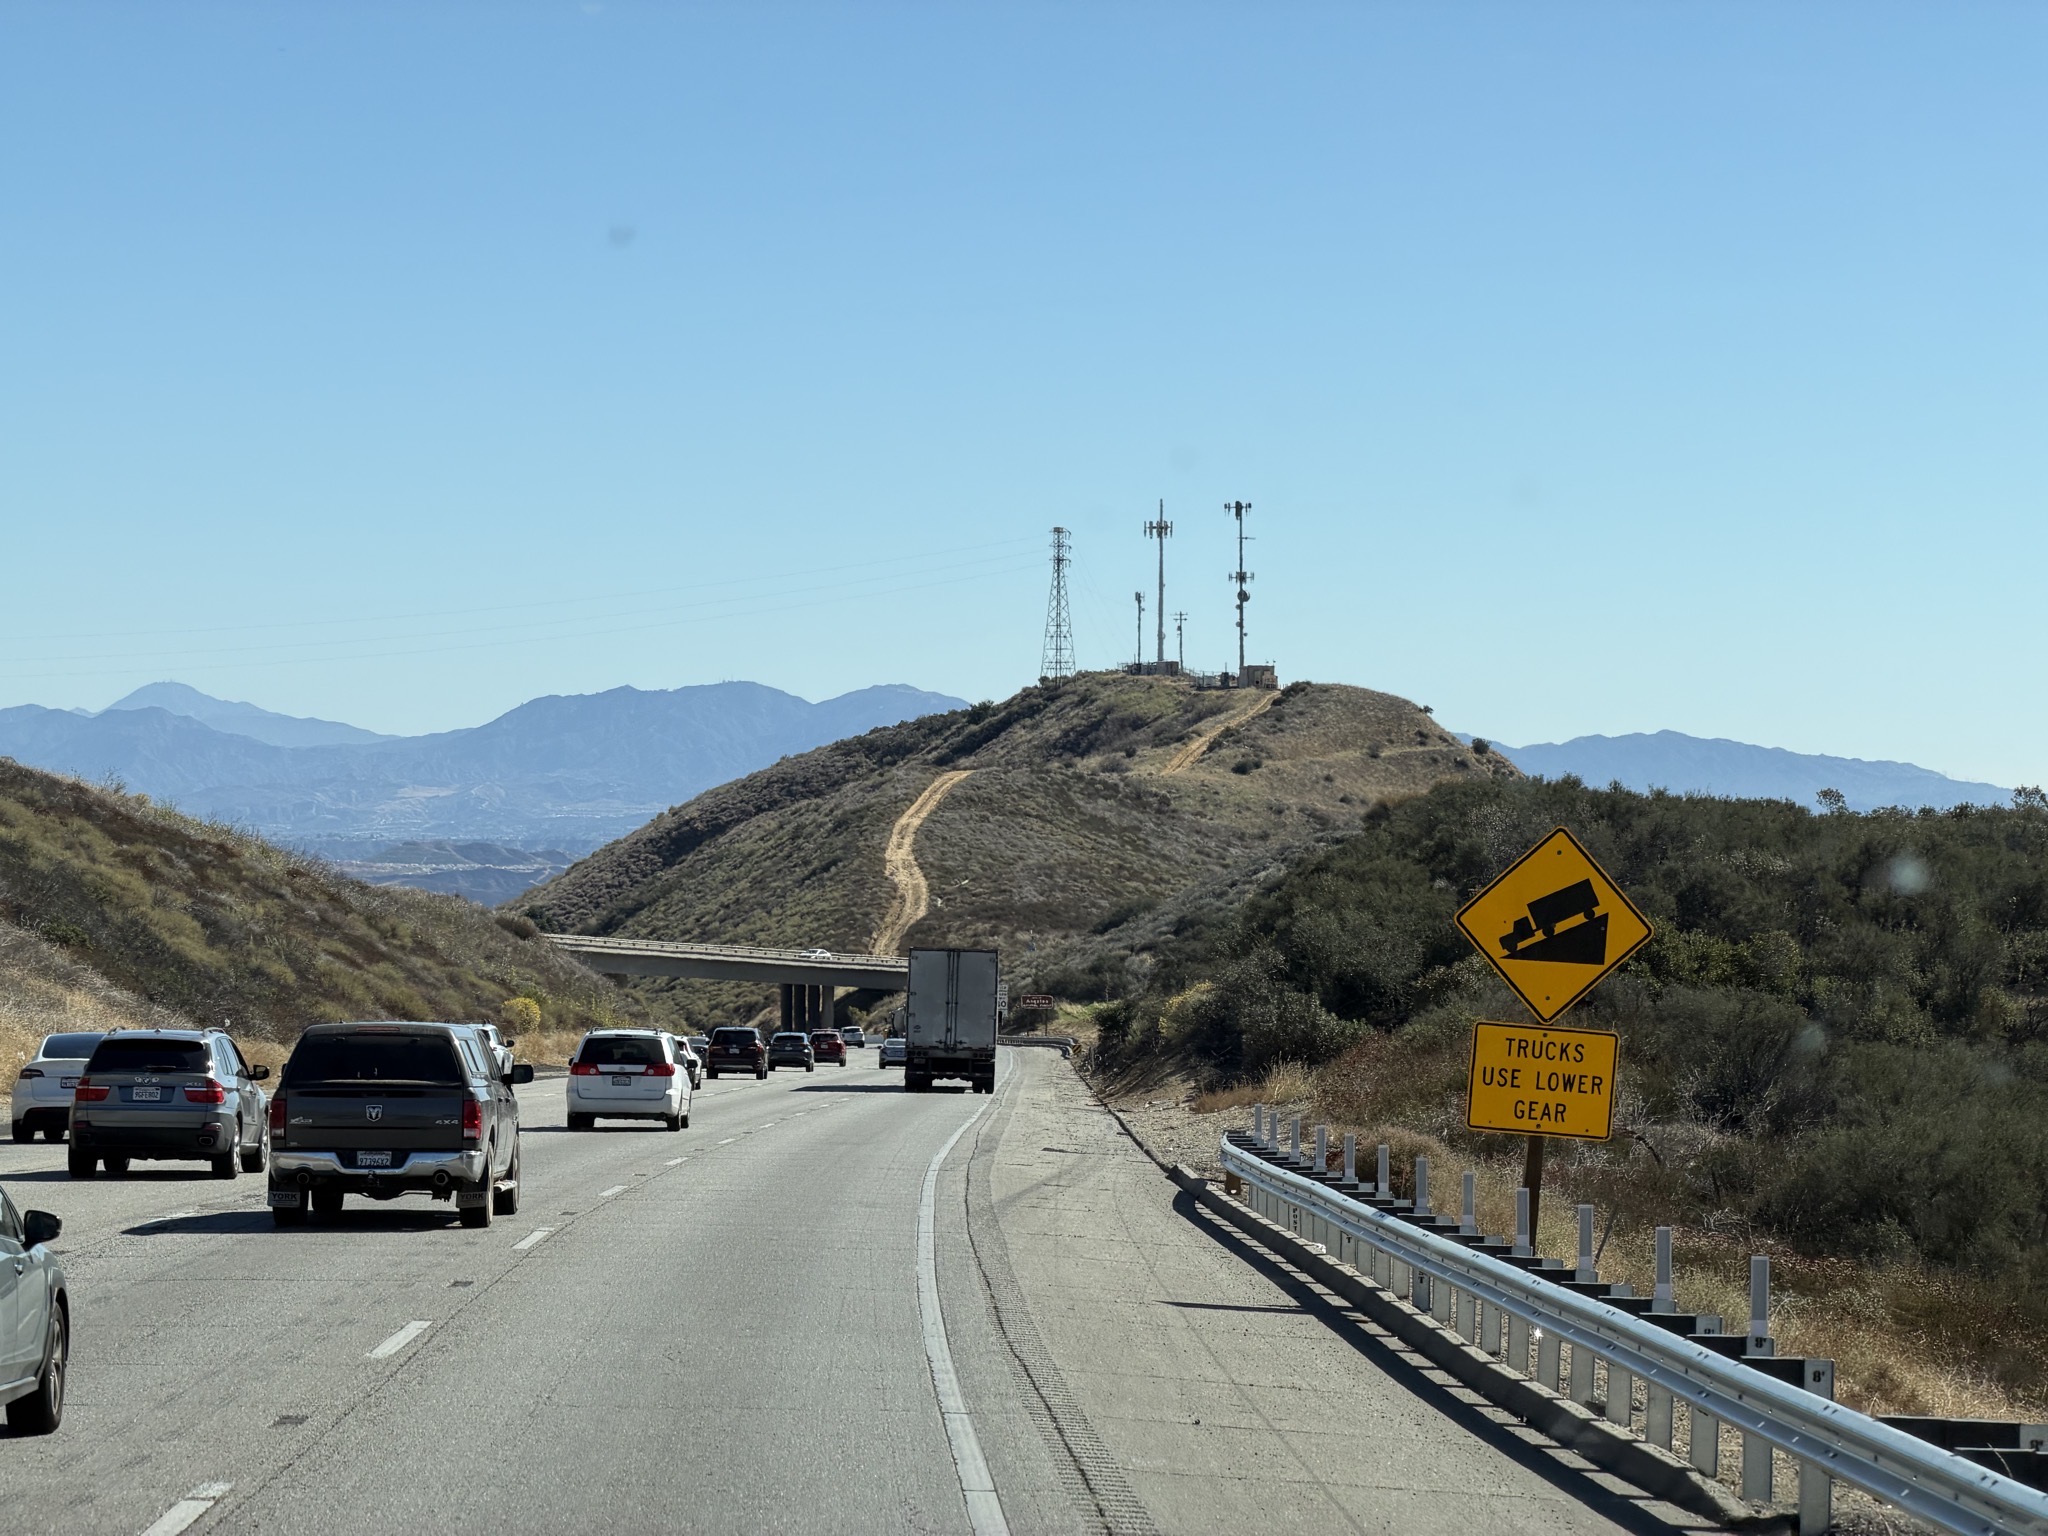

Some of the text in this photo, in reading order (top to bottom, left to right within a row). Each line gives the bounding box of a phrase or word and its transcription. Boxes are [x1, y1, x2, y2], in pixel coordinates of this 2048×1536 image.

[1506, 1038, 1584, 1063] TRUCKS
[1482, 1066, 1603, 1095] USE LOWER
[1514, 1100, 1566, 1122] GEAR
[1813, 1370, 1825, 1383] 8'
